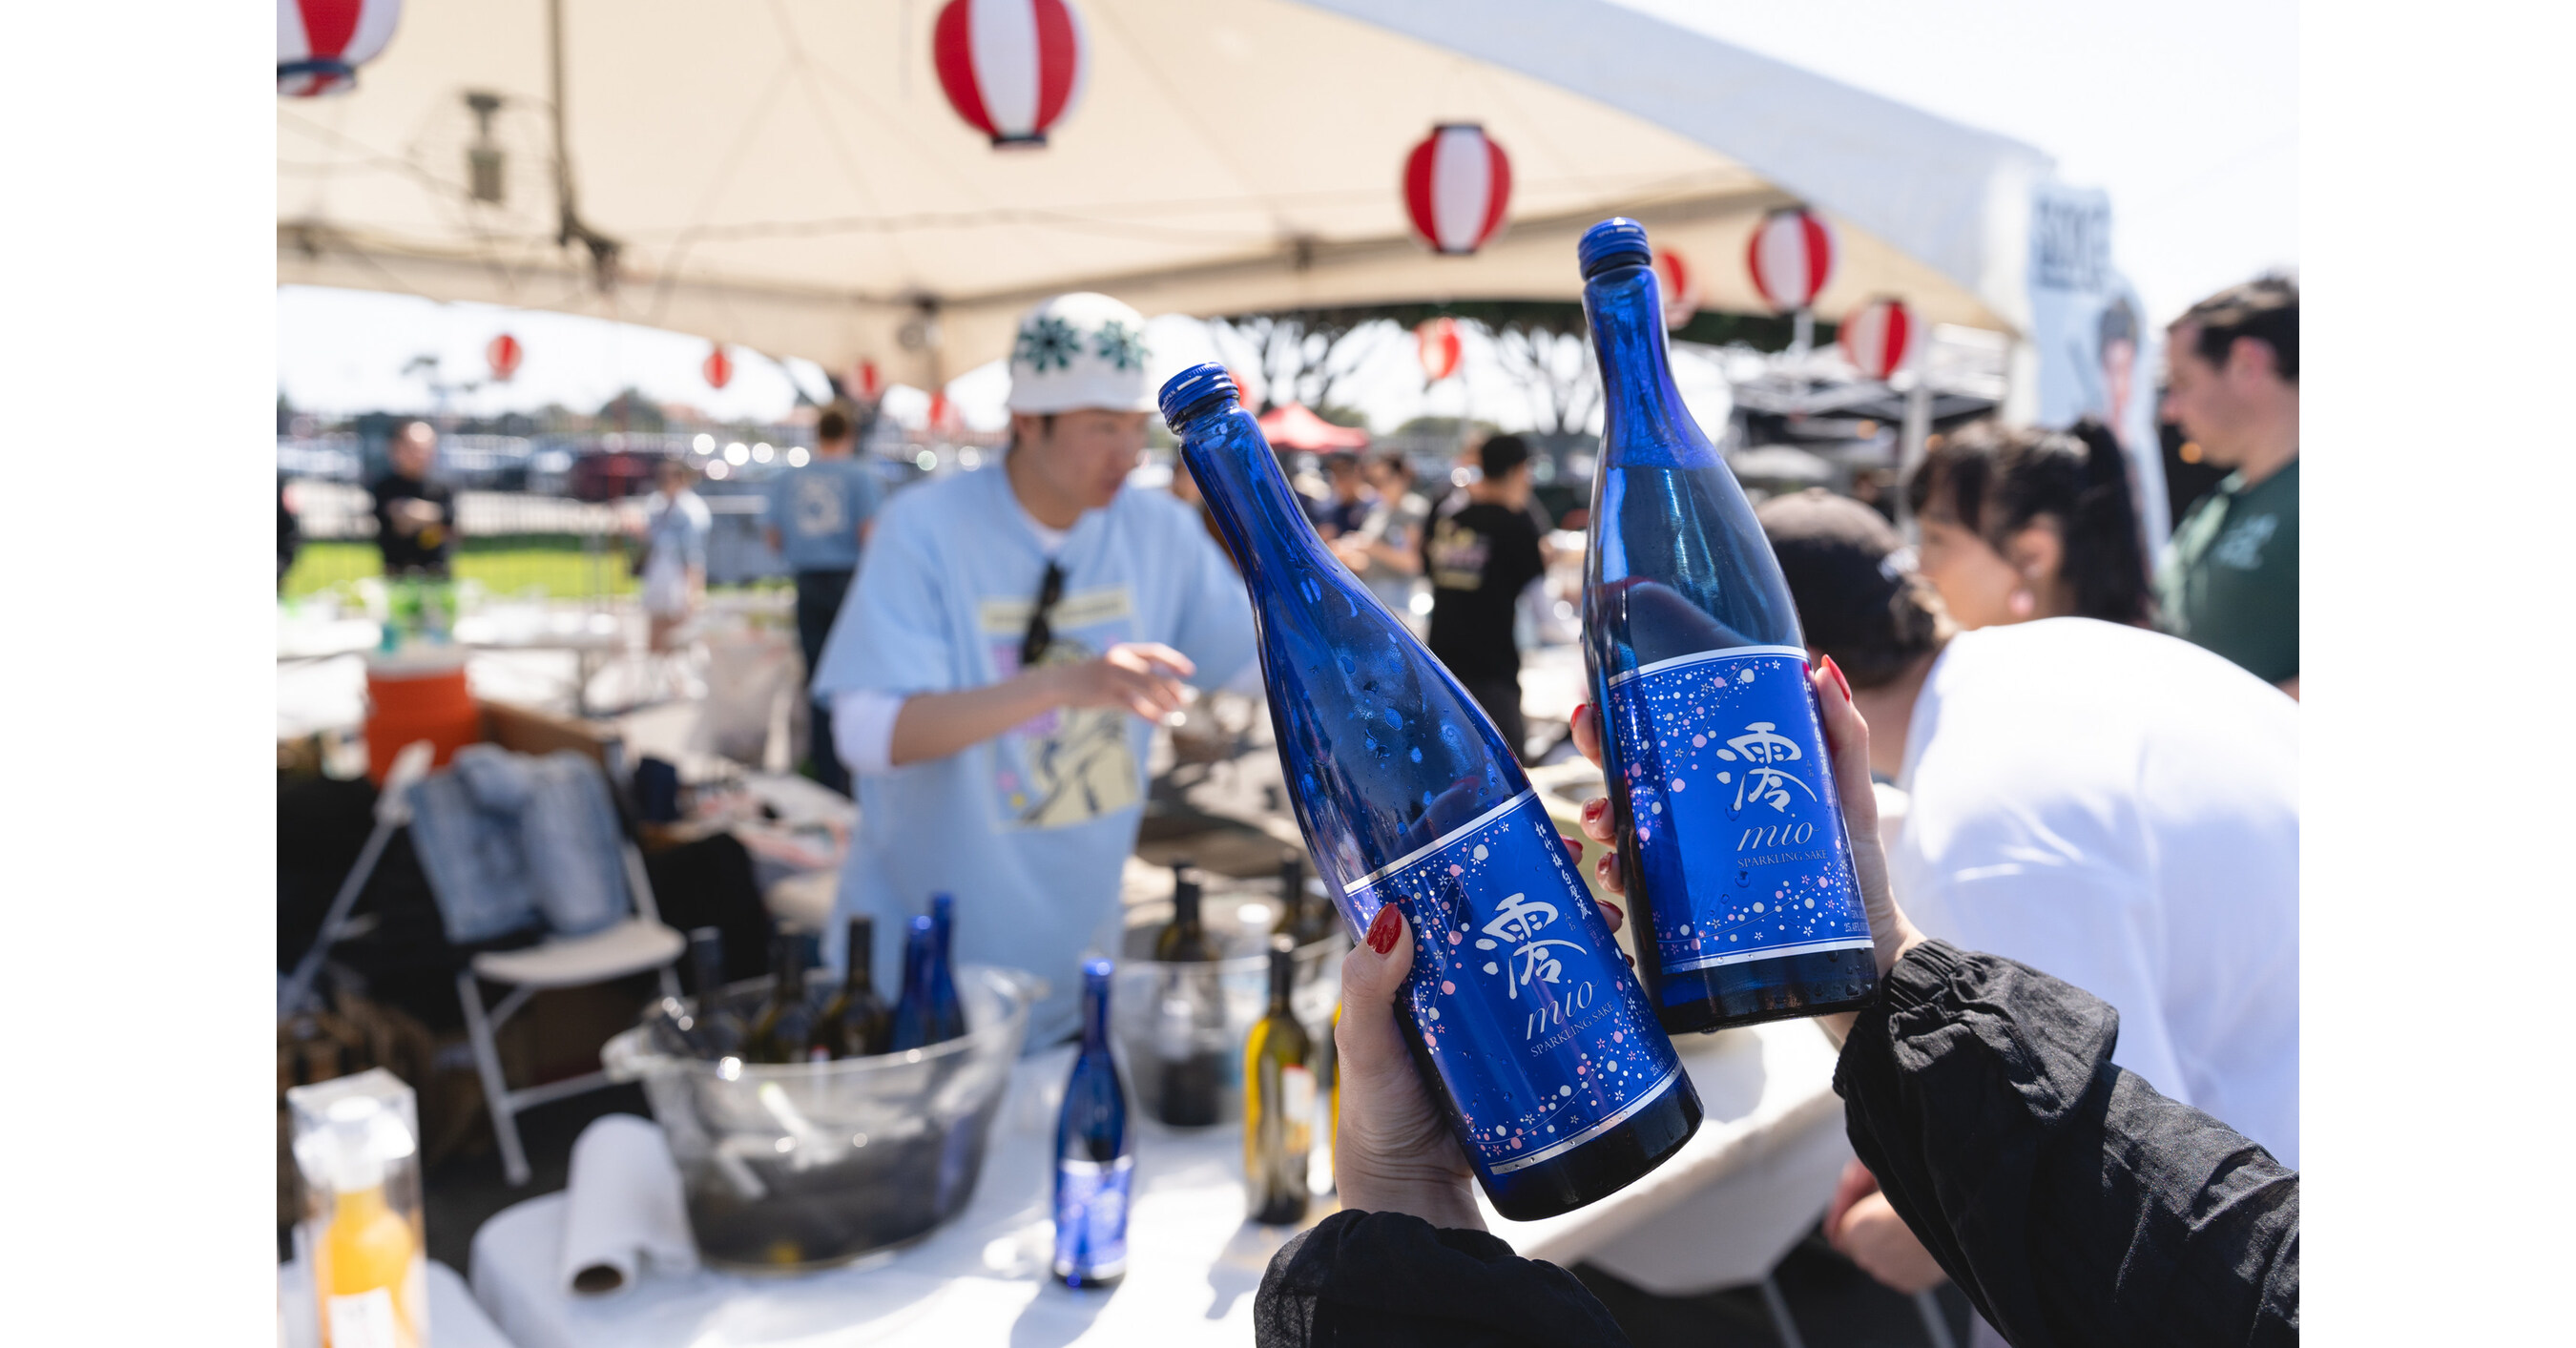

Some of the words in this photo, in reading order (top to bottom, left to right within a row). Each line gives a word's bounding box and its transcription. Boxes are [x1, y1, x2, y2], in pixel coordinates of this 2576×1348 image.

[1716, 721, 1818, 811] 澪
[1737, 813, 1820, 851] mio
[1737, 851, 1802, 869] SPARKLING
[1804, 849, 1829, 860] SAKE
[1475, 892, 1588, 1000] 澪
[1527, 979, 1600, 1040] mio
[1530, 1016, 1592, 1058] SPARKLING
[1591, 1001, 1615, 1023] SAKE
